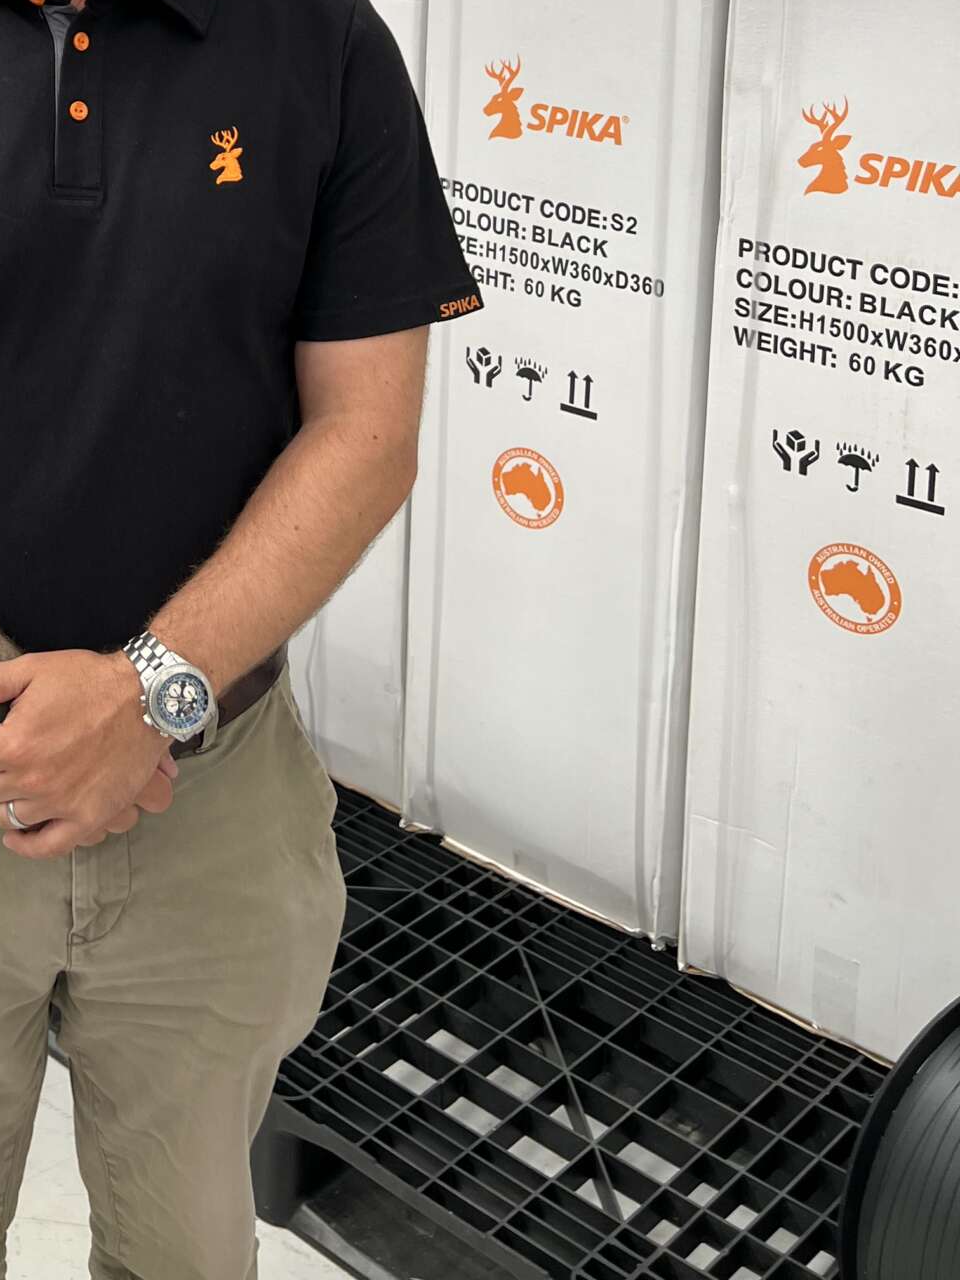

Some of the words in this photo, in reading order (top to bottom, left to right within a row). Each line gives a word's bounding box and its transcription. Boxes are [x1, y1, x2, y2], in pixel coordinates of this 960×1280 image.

[526, 103, 623, 146] SPIKA
[854, 153, 960, 198] SPIK
[440, 177, 535, 215] PRODUCT
[539, 199, 639, 235] CODE:S2
[451, 207, 527, 241] OLOUR:
[532, 225, 609, 258] BLACK
[456, 233, 665, 298] ZE:H1500xW360xD360
[470, 264, 516, 292] GHT:
[524, 278, 545, 298] 60
[550, 284, 582, 309] KG
[739, 238, 864, 280] PRODUCT
[869, 263, 960, 299] CODE:
[440, 294, 481, 318] SPIKA
[736, 268, 852, 310] COLOUR:
[858, 292, 960, 331] BLACK
[733, 325, 837, 368] WEIGHT:
[848, 353, 876, 376] 60
[883, 361, 925, 387] KG
[734, 297, 960, 364] SIZE:H1500xW360x
[816, 544, 867, 564] AUSTRALIAN
[868, 555, 895, 584] OWNED
[812, 588, 856, 631] AUSTRALIAN
[856, 612, 896, 633] OPERATED
